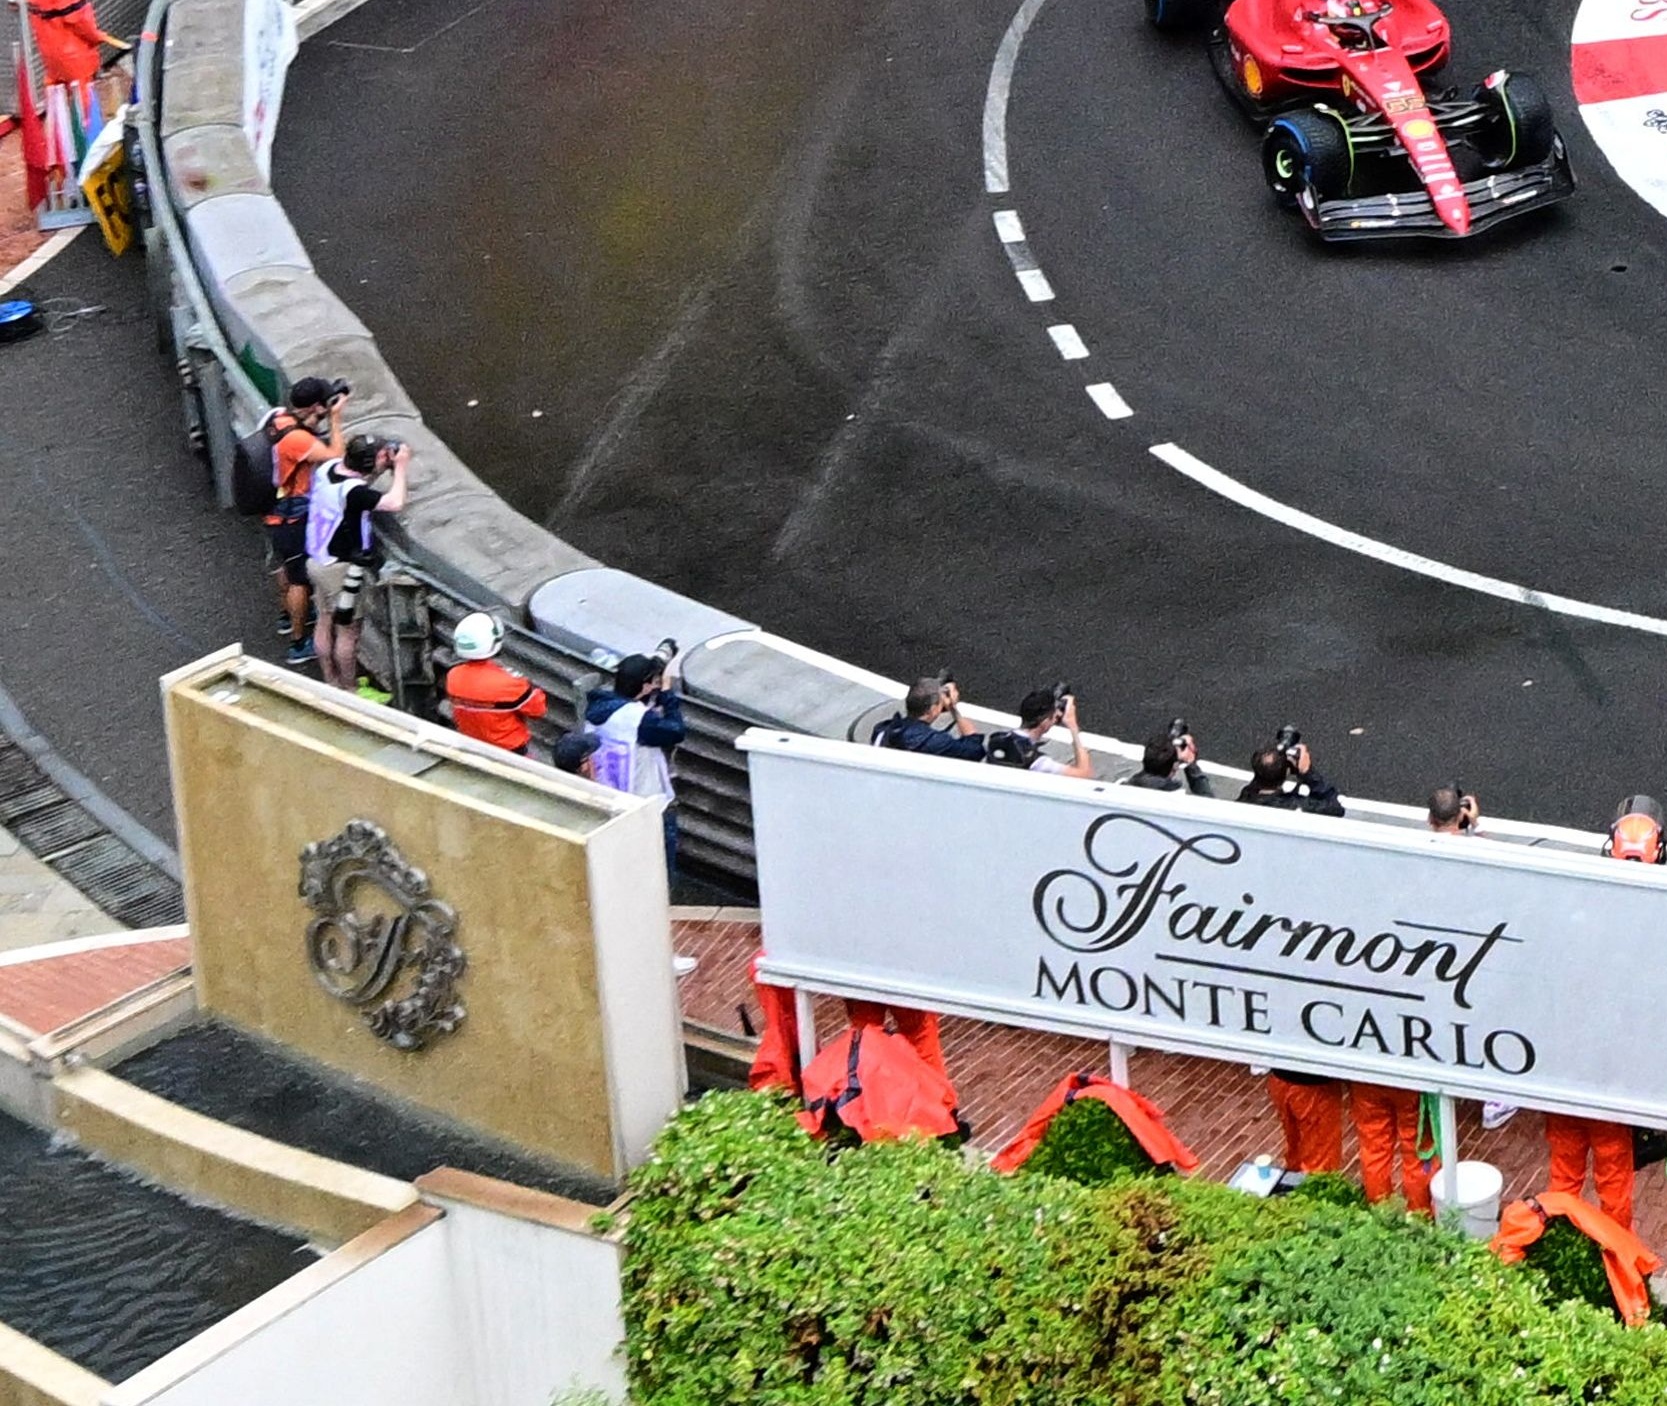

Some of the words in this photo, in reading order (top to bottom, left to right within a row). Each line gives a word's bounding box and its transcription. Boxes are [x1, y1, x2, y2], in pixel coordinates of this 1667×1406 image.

[1031, 811, 1525, 1010] Fairmont
[1034, 958, 1271, 1036] MONTE
[1301, 998, 1537, 1077] CARLO
